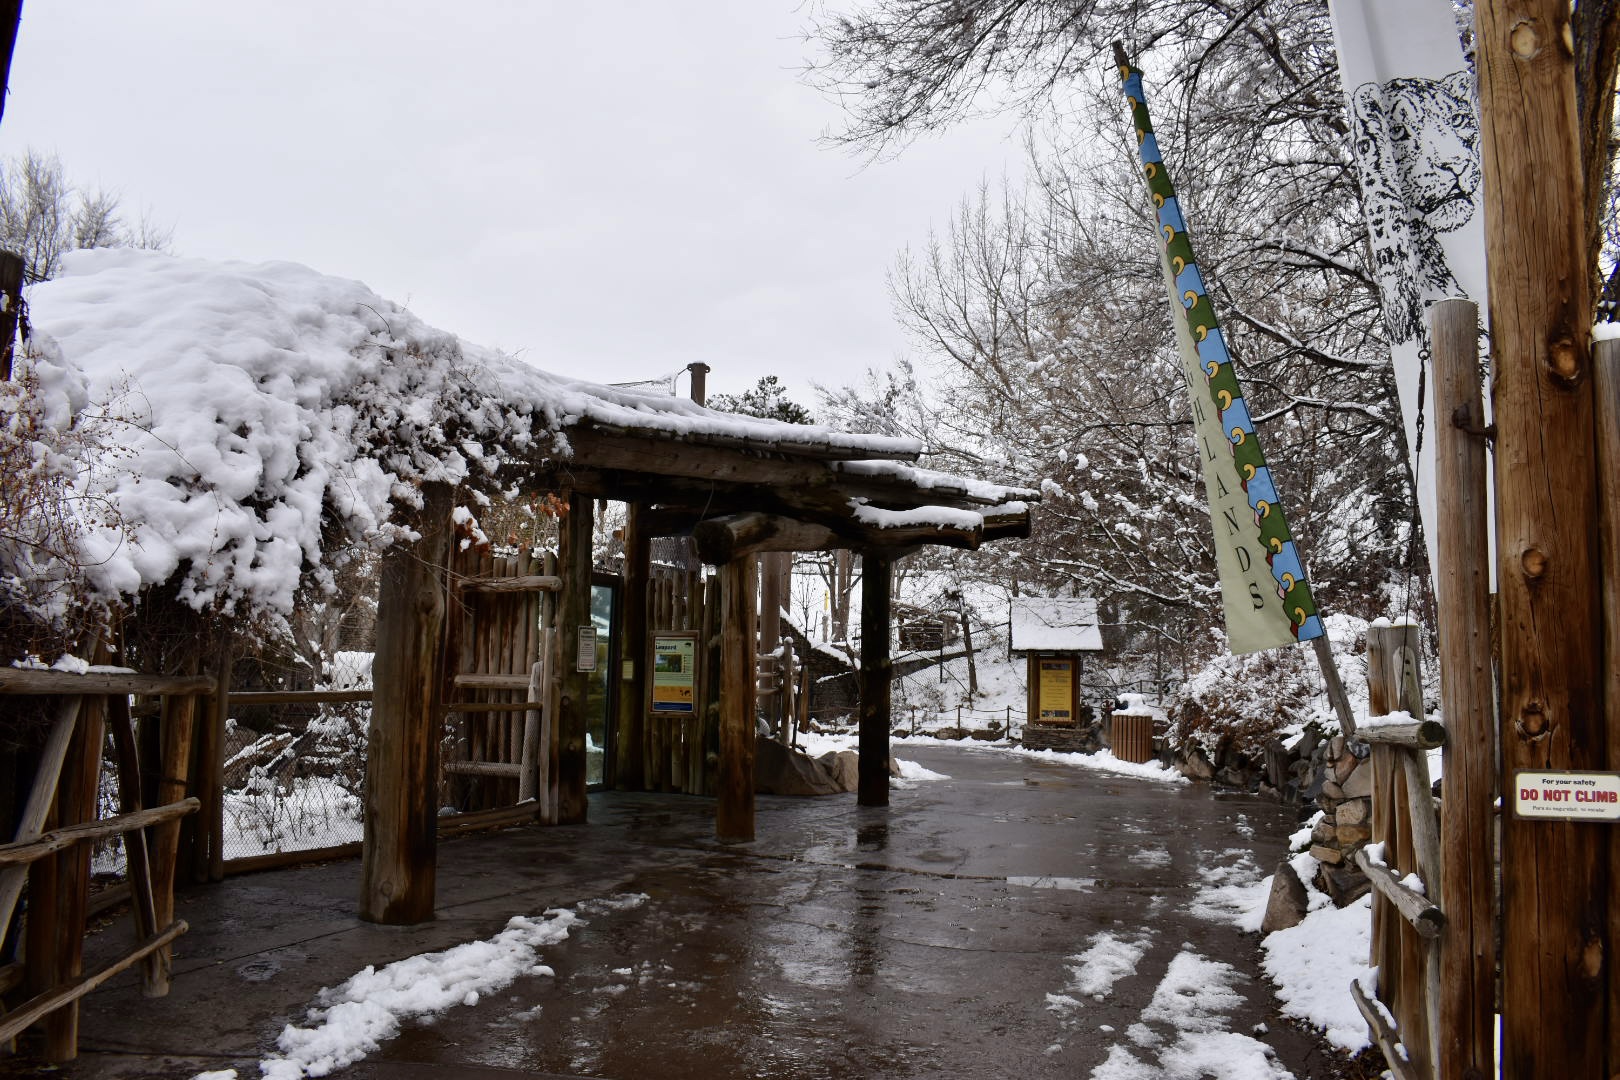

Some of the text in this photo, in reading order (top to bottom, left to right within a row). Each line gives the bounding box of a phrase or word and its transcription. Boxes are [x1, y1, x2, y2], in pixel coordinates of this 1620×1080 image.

[1520, 788, 1618, 803] DO NOT CLIMB
